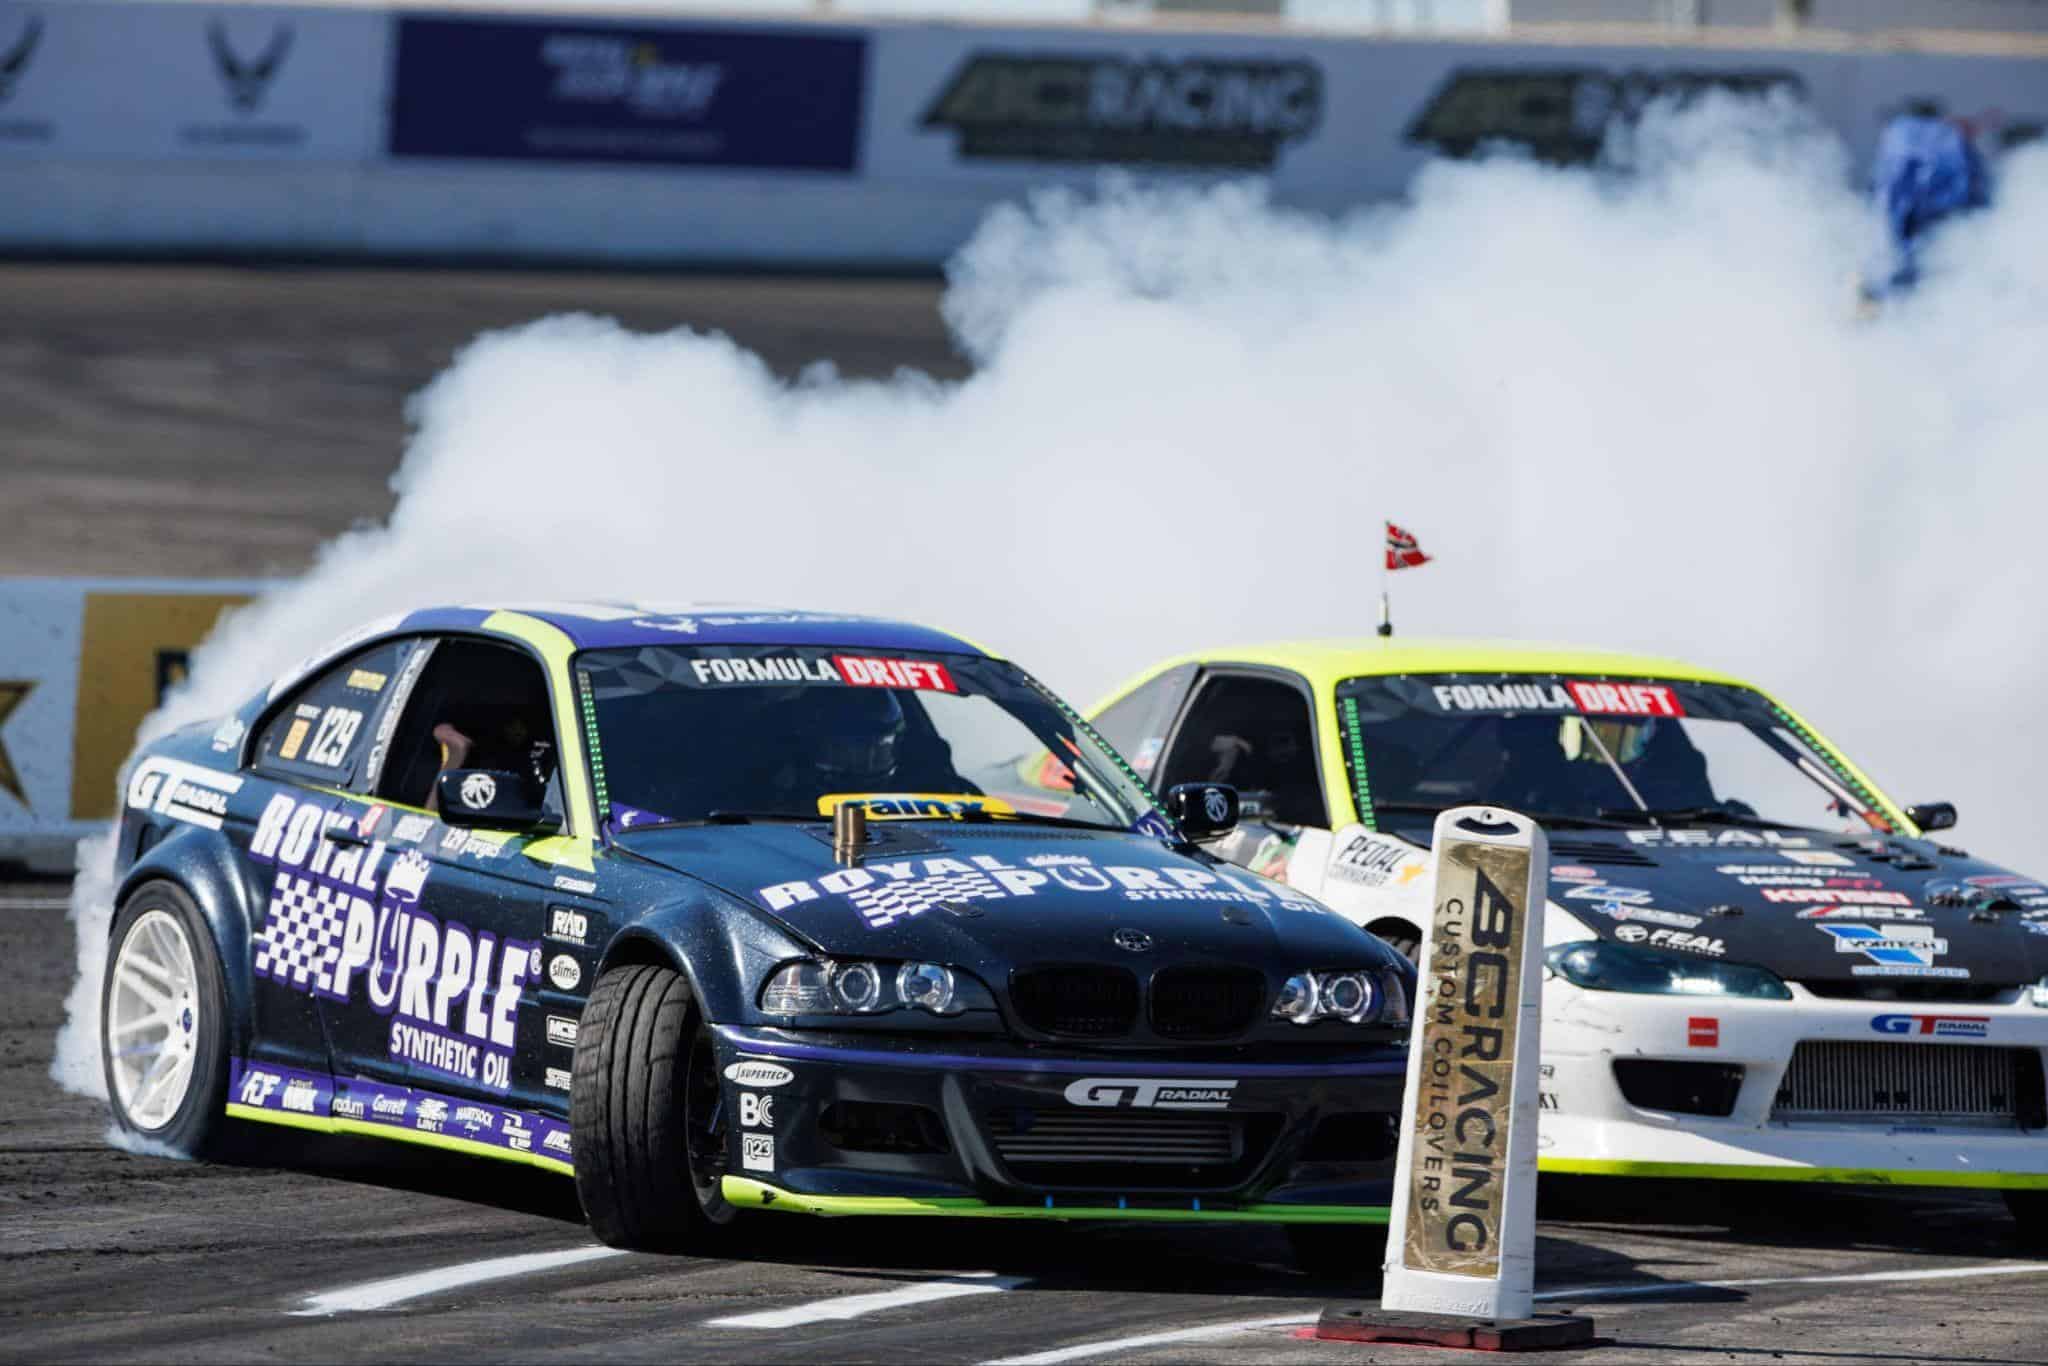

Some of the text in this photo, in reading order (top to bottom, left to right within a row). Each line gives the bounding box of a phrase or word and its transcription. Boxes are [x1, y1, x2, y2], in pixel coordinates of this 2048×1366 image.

[690, 657, 946, 690] FORMULA DRIFT
[1433, 683, 1676, 714] FORMULA DRIFT
[306, 706, 364, 767] 129
[251, 794, 387, 891] ROYAL
[759, 854, 1017, 911] ROYAL
[552, 909, 588, 938] RAD
[1650, 928, 1727, 954] FEAL
[552, 960, 578, 981] slime
[391, 1021, 477, 1079] SYNTHETIC
[483, 1052, 510, 1089] OIL
[1421, 898, 1464, 1212] CUSTOM COILOVERS
[740, 1068, 789, 1081] SUPERTECH
[741, 1092, 774, 1128] BC
[1159, 1090, 1232, 1101] RADIAL
